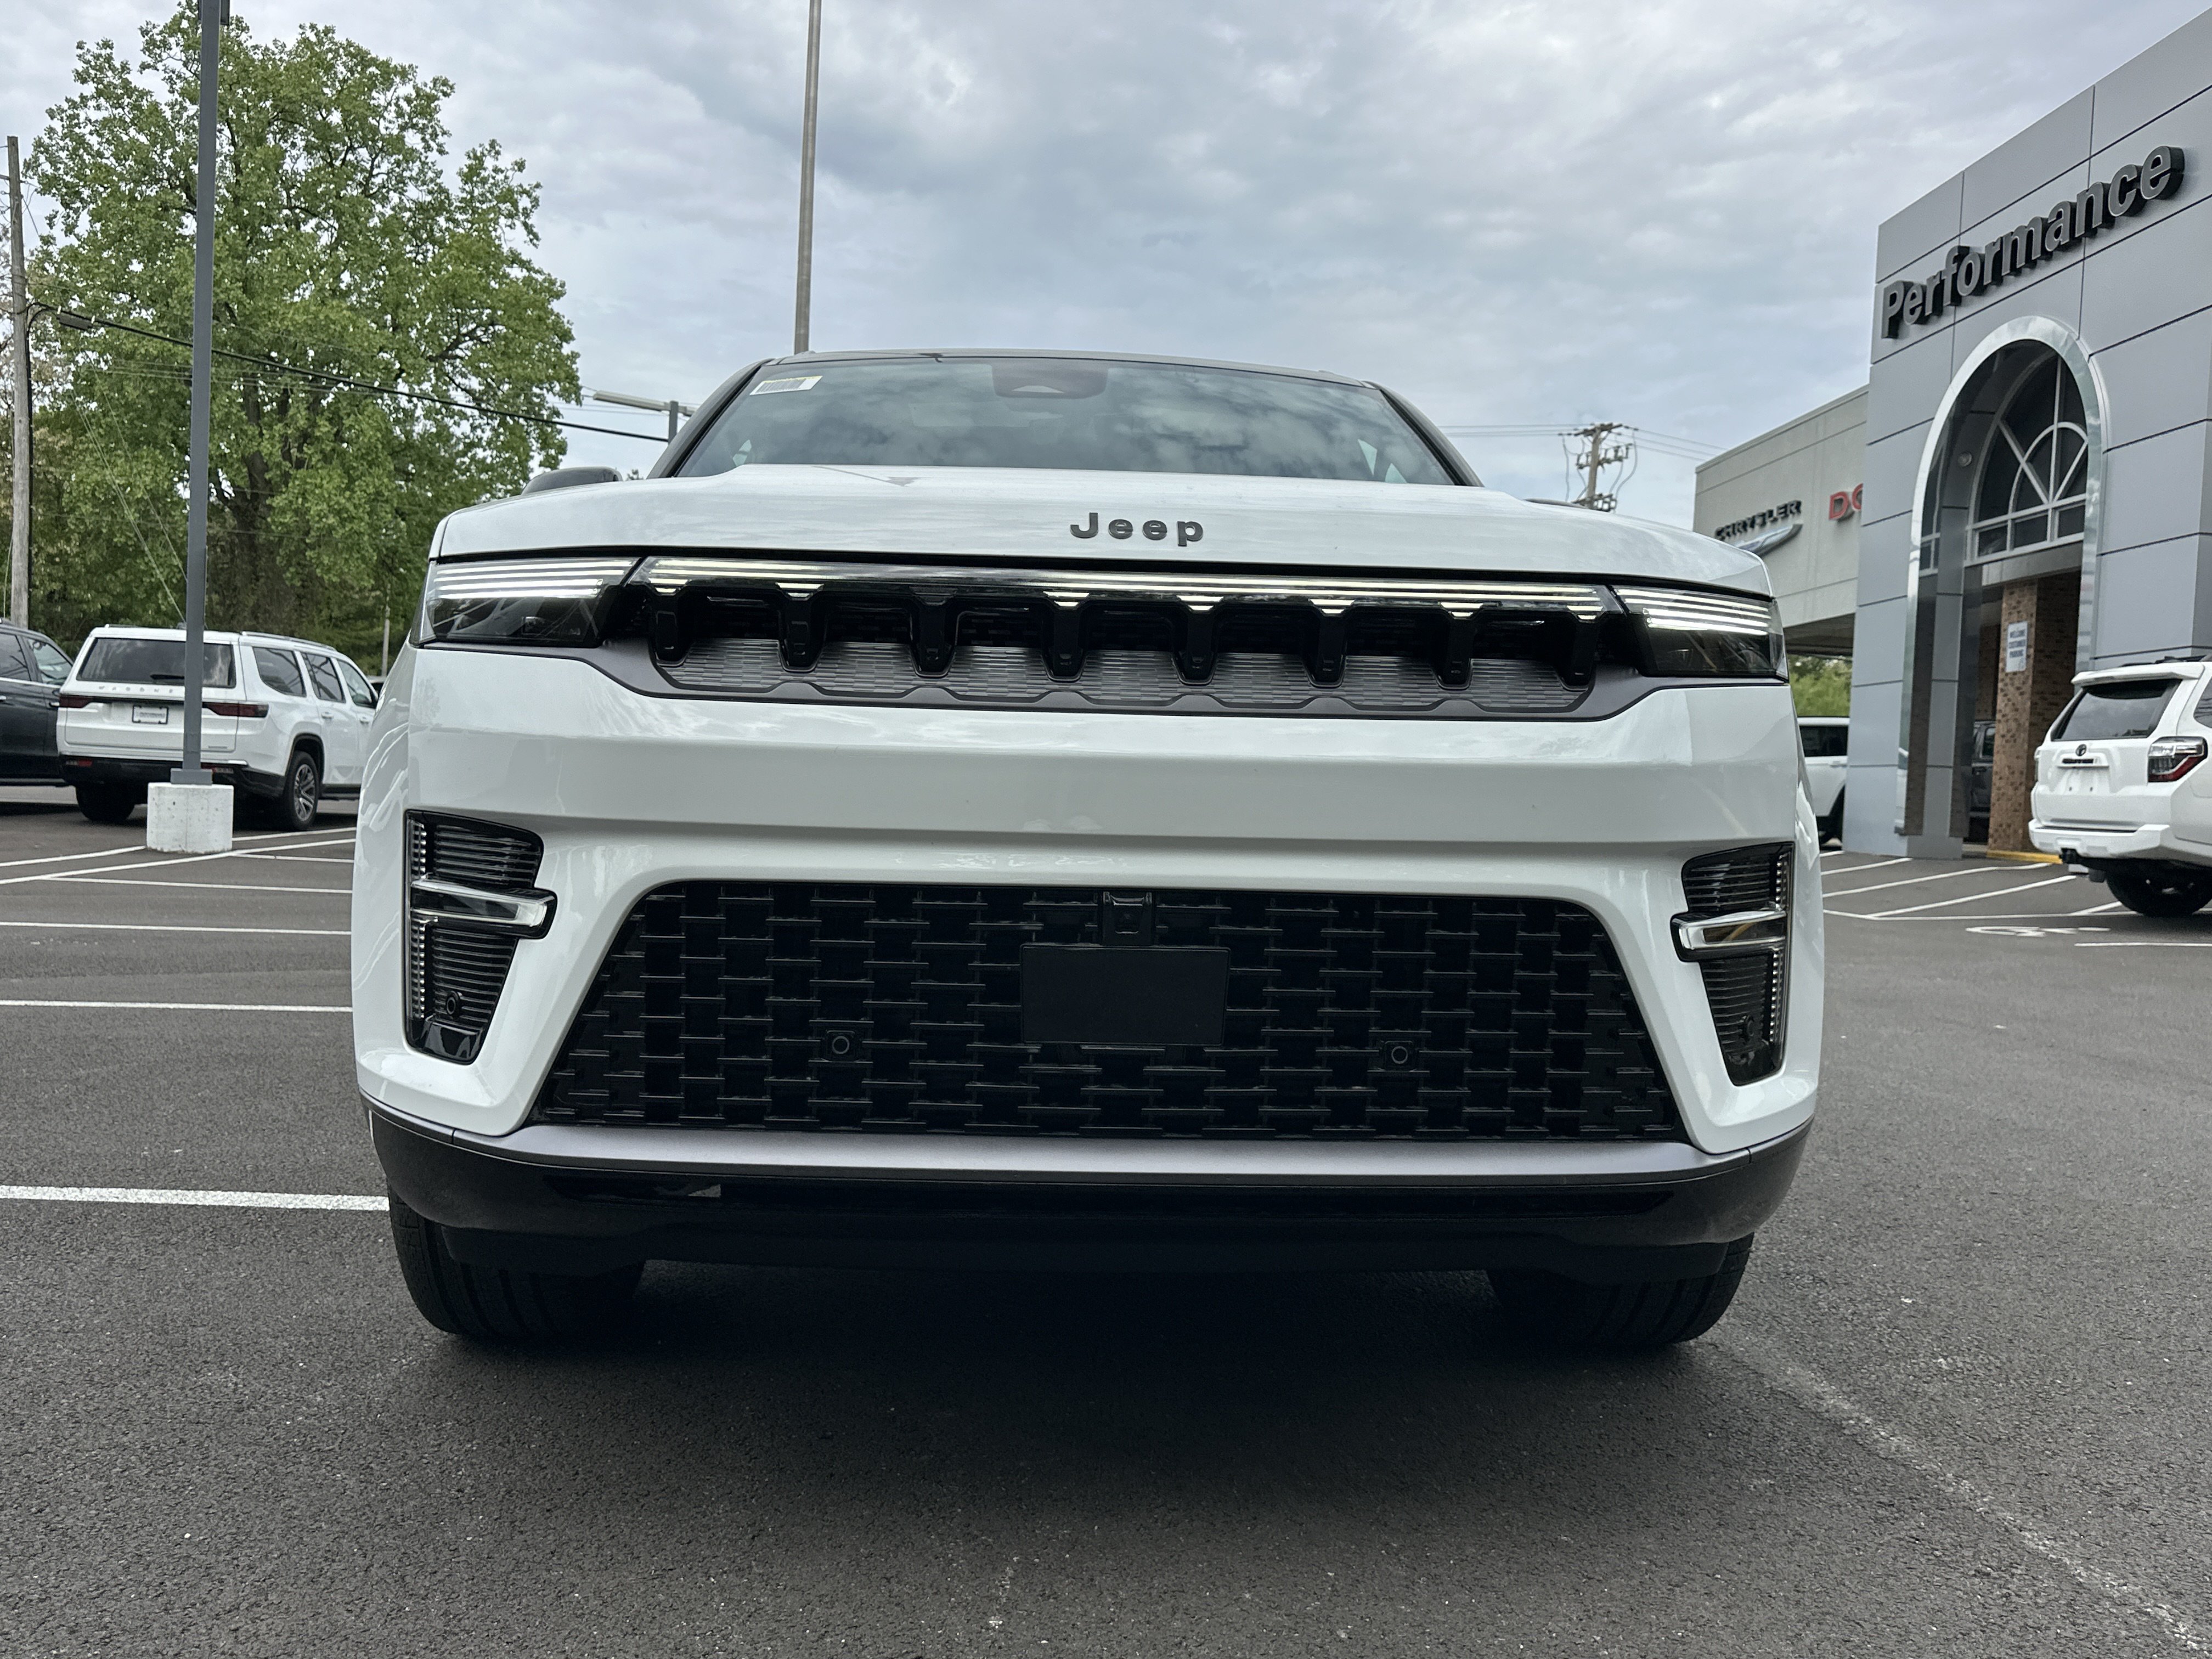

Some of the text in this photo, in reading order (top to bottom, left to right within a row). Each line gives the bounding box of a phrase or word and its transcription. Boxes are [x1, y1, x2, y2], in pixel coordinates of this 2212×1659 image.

[1882, 145, 2185, 338] Performance
[1070, 512, 1204, 547] Jeep
[1714, 500, 1802, 541] CHRYSLER
